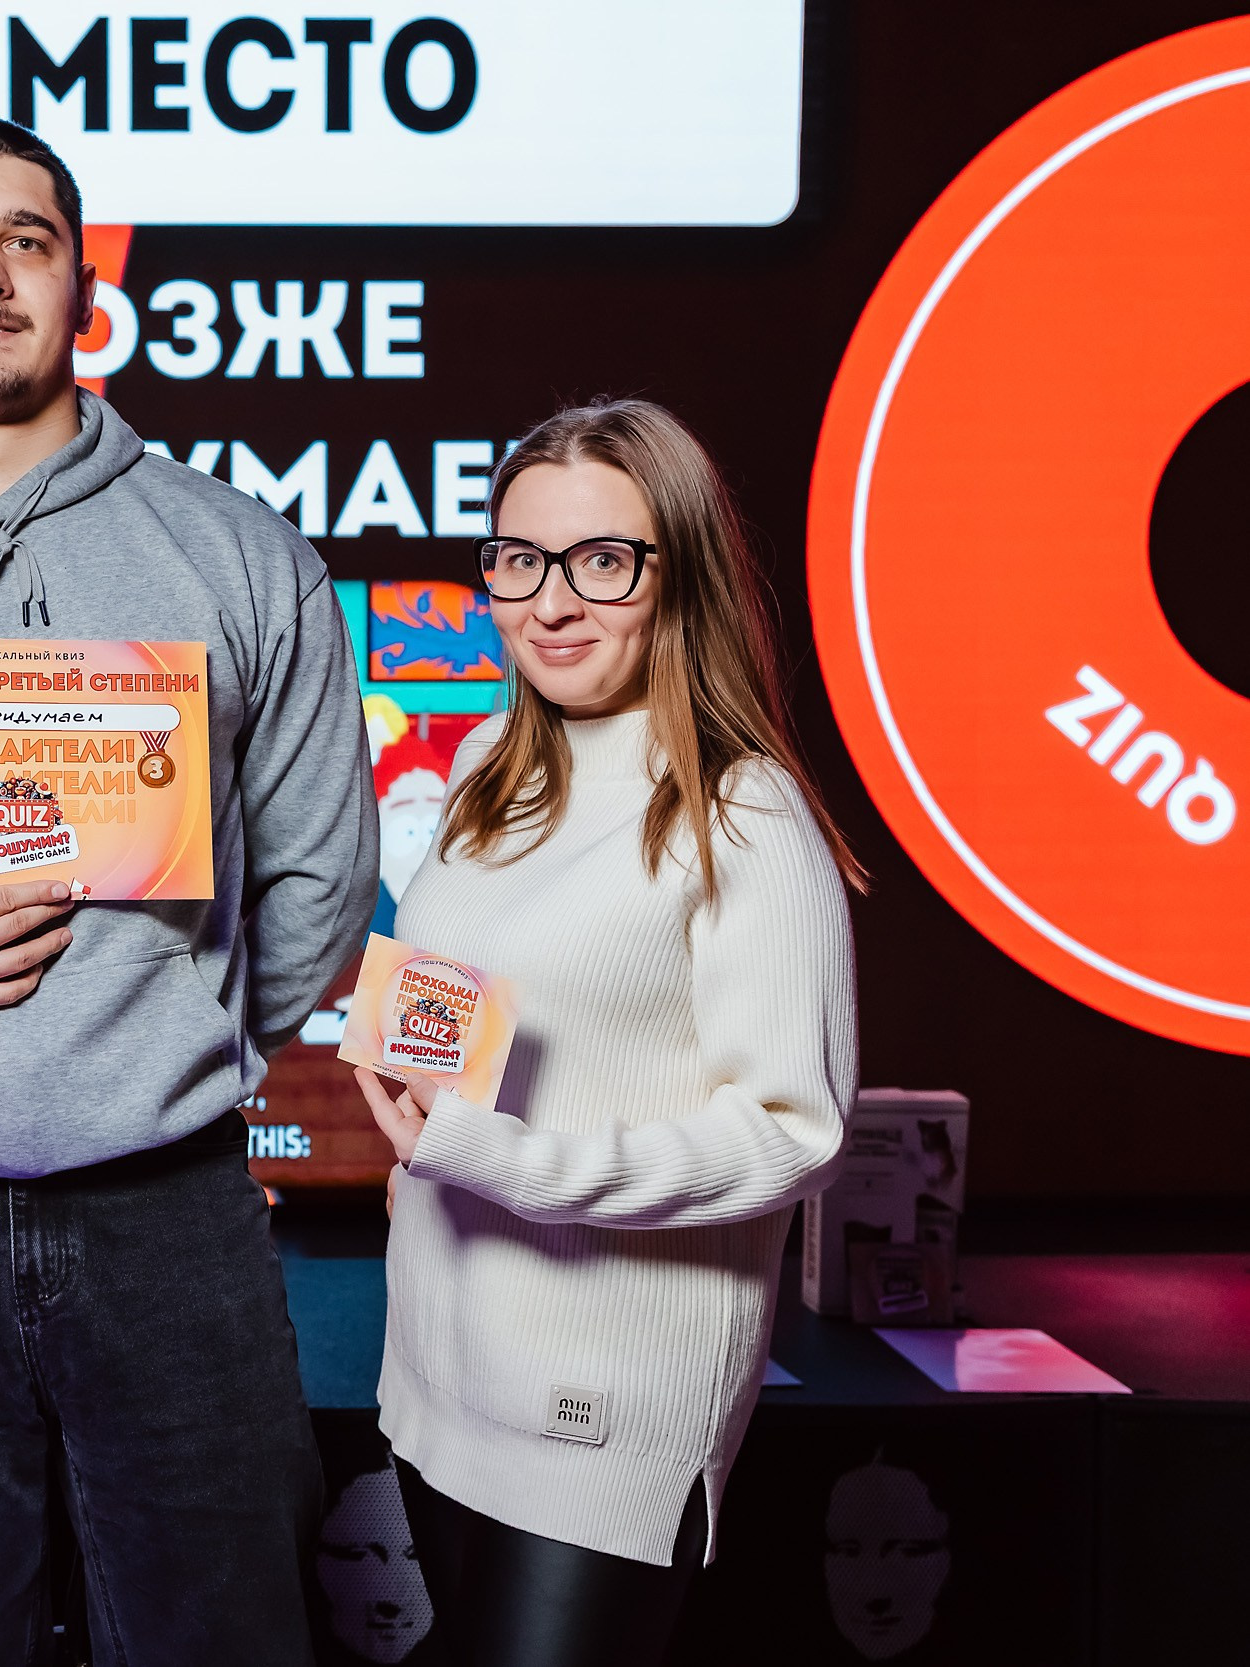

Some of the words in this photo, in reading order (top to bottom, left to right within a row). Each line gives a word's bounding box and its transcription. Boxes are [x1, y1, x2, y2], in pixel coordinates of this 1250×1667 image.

[7, 15, 479, 135] МЕСТО
[74, 278, 425, 380] ОЗЖЕ
[55, 652, 85, 661] КВИЗ
[89, 672, 200, 693] СТЕПЕНИ
[1044, 663, 1237, 846] QUIZ
[149, 759, 164, 780] 3
[9, 851, 44, 865] #MUSIC
[46, 846, 71, 860] GAME
[402, 968, 479, 1002] ПРОХОДКА!
[408, 1015, 451, 1043] QUIZ
[389, 1042, 461, 1060] #ПОШУМИМ?
[412, 1056, 437, 1066] #MUSIC
[438, 1060, 458, 1068] GAME
